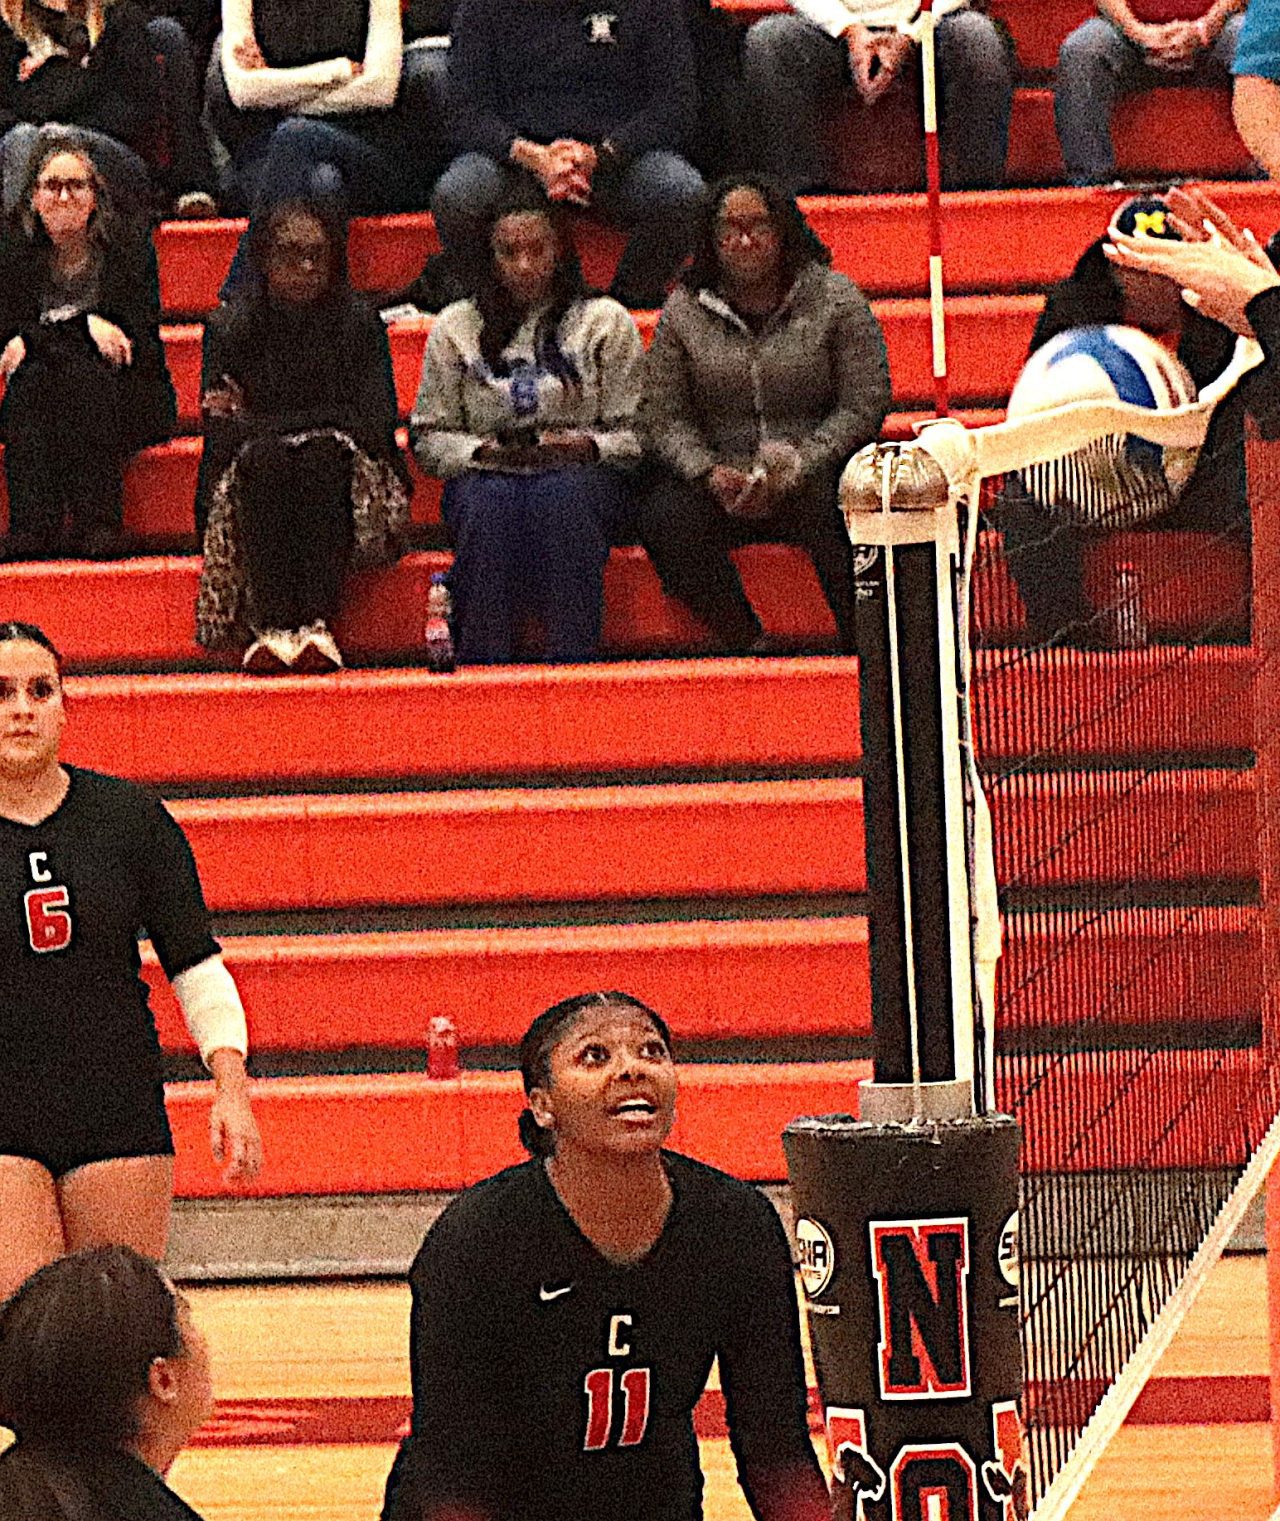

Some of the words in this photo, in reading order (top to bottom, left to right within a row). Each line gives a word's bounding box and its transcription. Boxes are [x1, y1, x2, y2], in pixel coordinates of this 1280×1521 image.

[29, 851, 52, 882] C
[24, 885, 72, 952] 6
[608, 1315, 632, 1356] C
[583, 1368, 650, 1450] 11
